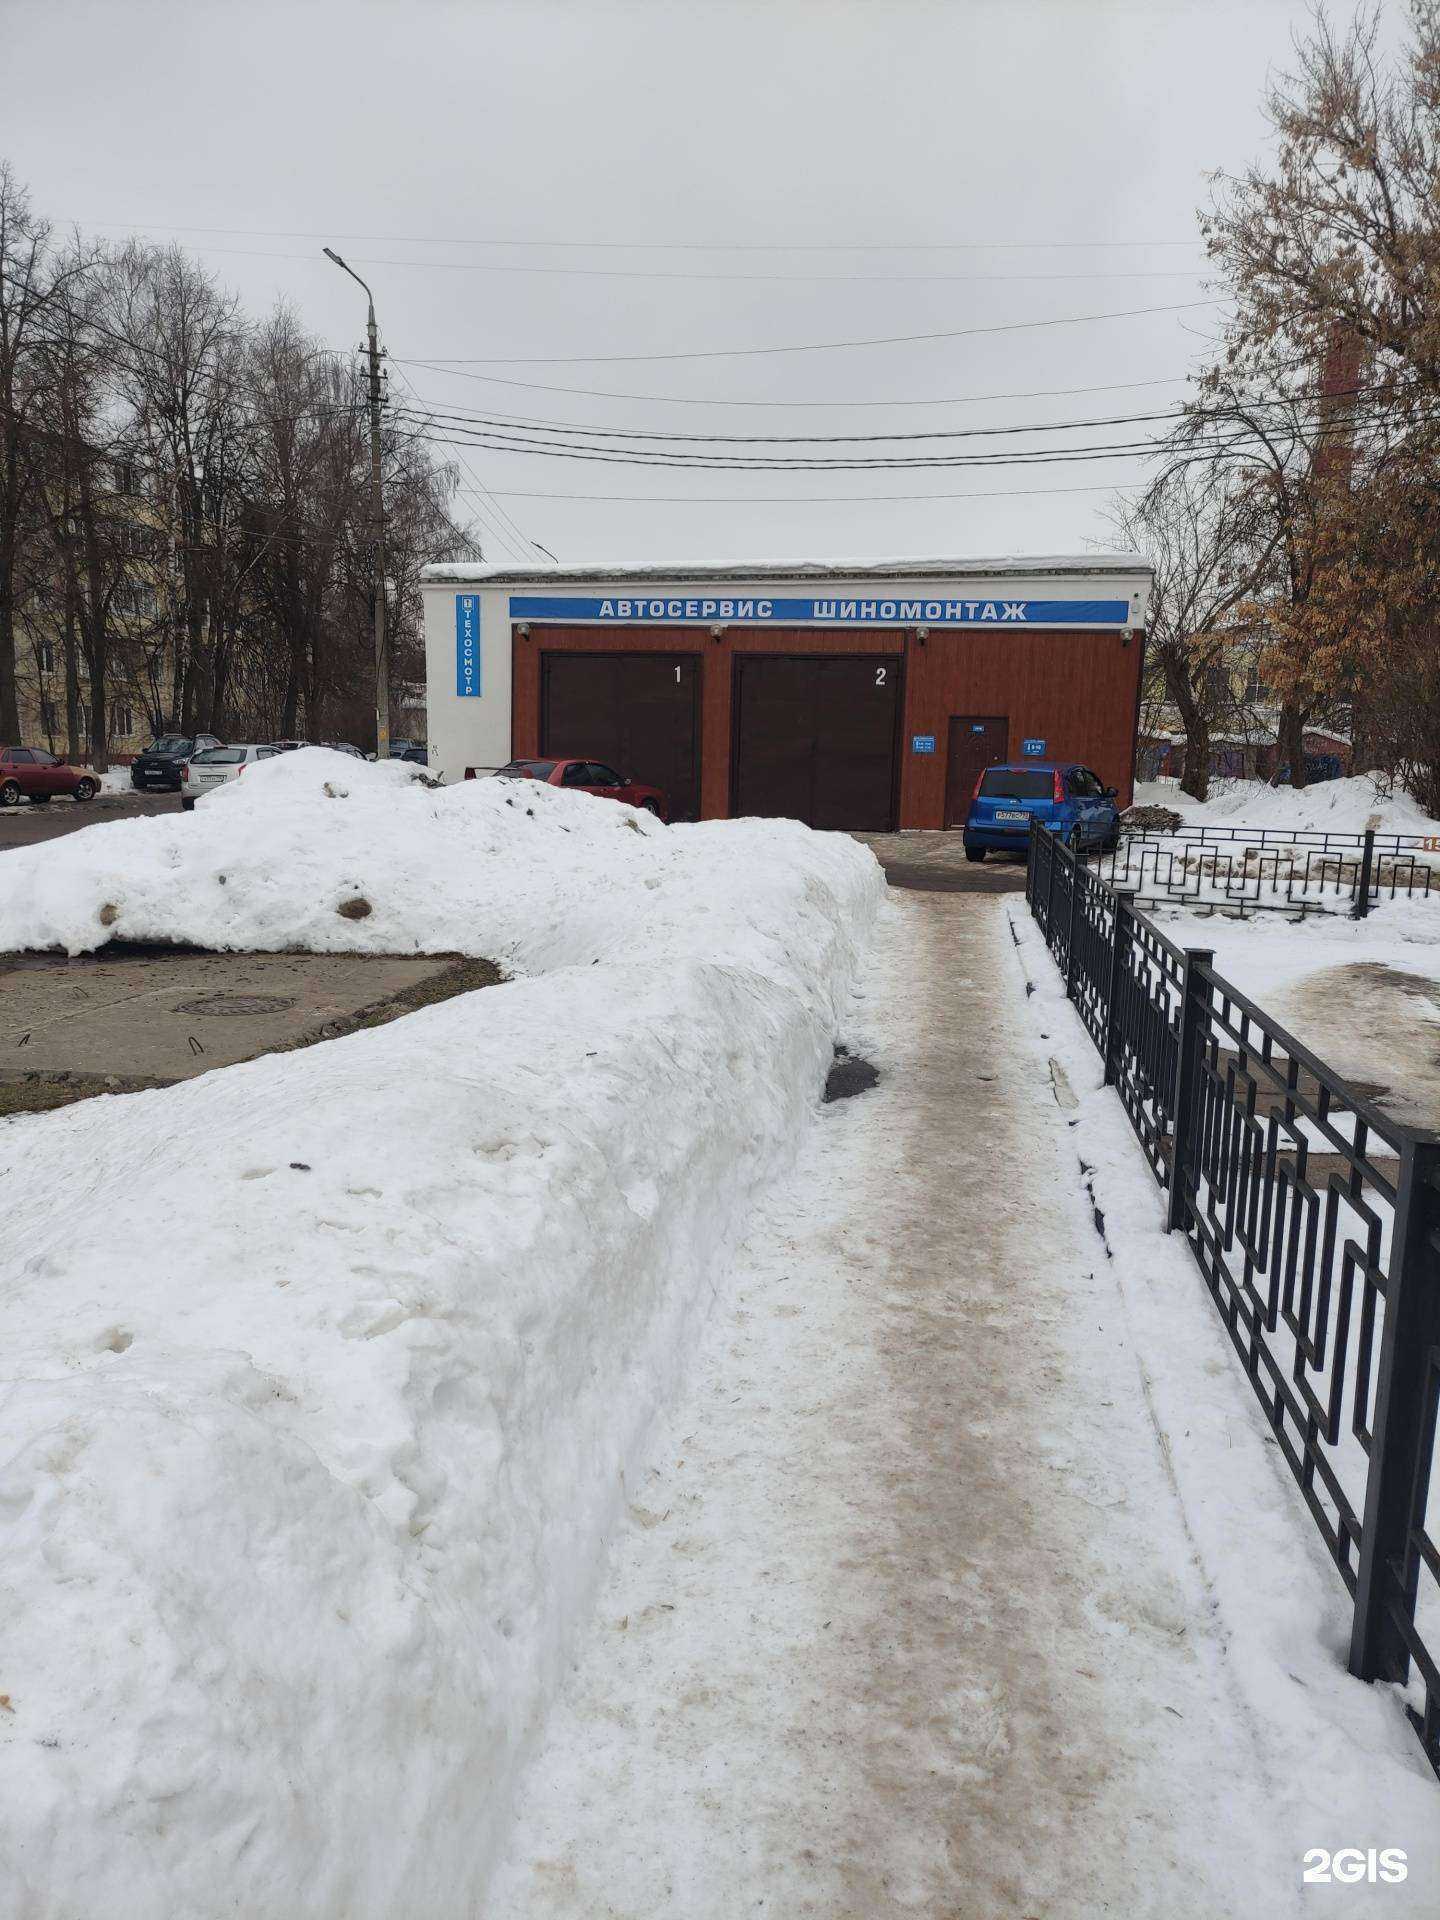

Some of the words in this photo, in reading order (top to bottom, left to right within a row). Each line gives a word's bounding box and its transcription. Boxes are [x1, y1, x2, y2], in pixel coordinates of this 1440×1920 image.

[599, 600, 773, 617] АВТОСЕРВИС
[813, 601, 1028, 620] ШИНОМОНТАЖ
[464, 610, 473, 694] ТЕХОСМОТР
[674, 665, 681, 683] 1
[875, 667, 887, 685] 2
